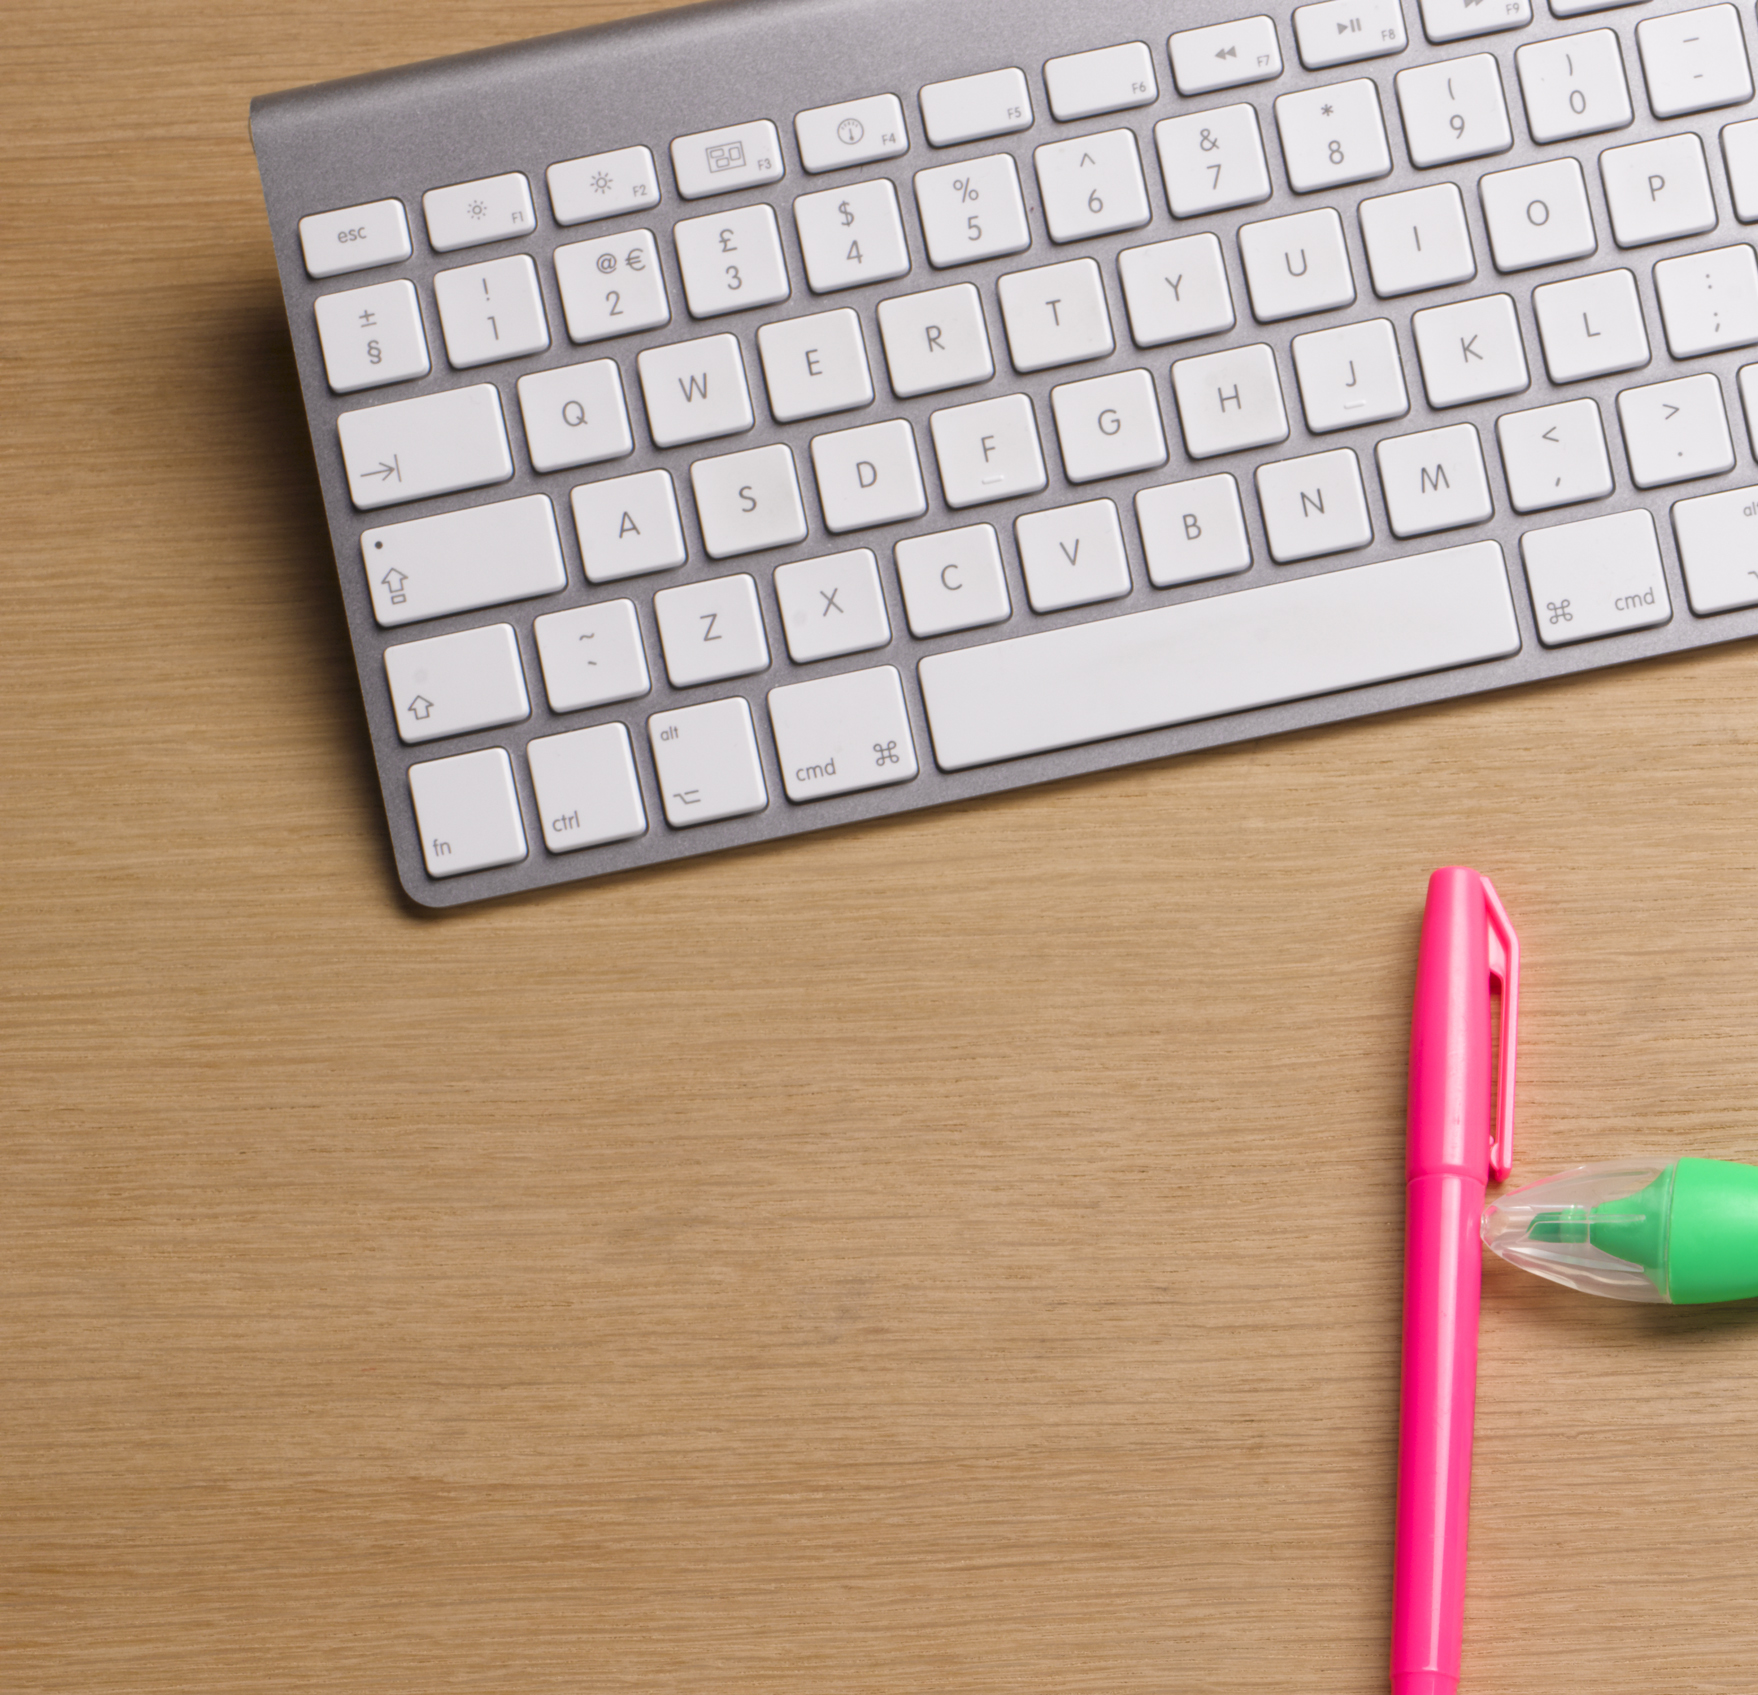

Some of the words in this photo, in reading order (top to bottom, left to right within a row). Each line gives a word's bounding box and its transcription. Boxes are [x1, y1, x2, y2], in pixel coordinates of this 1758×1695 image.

[1505, 1, 1521, 15] F9
[1380, 28, 1397, 42] F8
[1255, 53, 1271, 68] F7
[1131, 81, 1147, 94] F6
[1006, 106, 1022, 120] F5
[1568, 89, 1587, 115] 0
[881, 132, 897, 146] F4
[1448, 113, 1466, 140] 9
[756, 157, 773, 171] F3
[1327, 139, 1345, 166] 8
[1206, 163, 1222, 190] 7
[1647, 174, 1666, 202] P
[631, 183, 648, 198] F2
[1087, 188, 1104, 214] 6
[510, 210, 525, 224] F1
[1525, 199, 1550, 227] O
[336, 226, 367, 244] esc
[967, 214, 983, 242] 5
[1412, 225, 1422, 252] I
[624, 247, 646, 272] €
[846, 239, 863, 264] 4
[1284, 248, 1308, 278] U
[725, 264, 743, 291] 3
[1164, 273, 1183, 302] Y
[605, 289, 624, 317] 2
[1045, 298, 1062, 327] T
[486, 315, 500, 341] 1
[1582, 311, 1602, 338] L
[924, 324, 946, 353] R
[1459, 334, 1484, 363] K
[804, 348, 823, 377] E
[1345, 360, 1358, 388] J
[677, 372, 708, 403] W
[1217, 383, 1242, 413] H
[561, 399, 588, 428] Q
[1097, 408, 1122, 437] G
[980, 434, 996, 463] F
[855, 460, 878, 489] D
[1420, 463, 1450, 494] M
[738, 485, 758, 513] S
[1299, 487, 1325, 518] N
[618, 510, 641, 539] A
[1181, 512, 1203, 541] B
[1058, 538, 1080, 567] V
[940, 563, 963, 592] C
[819, 587, 844, 617] X
[1613, 586, 1656, 612] cmd
[699, 612, 722, 643] Z
[659, 725, 679, 742] alt
[795, 757, 837, 782] cmd
[551, 809, 581, 833] ctrl
[432, 838, 452, 857] fn
